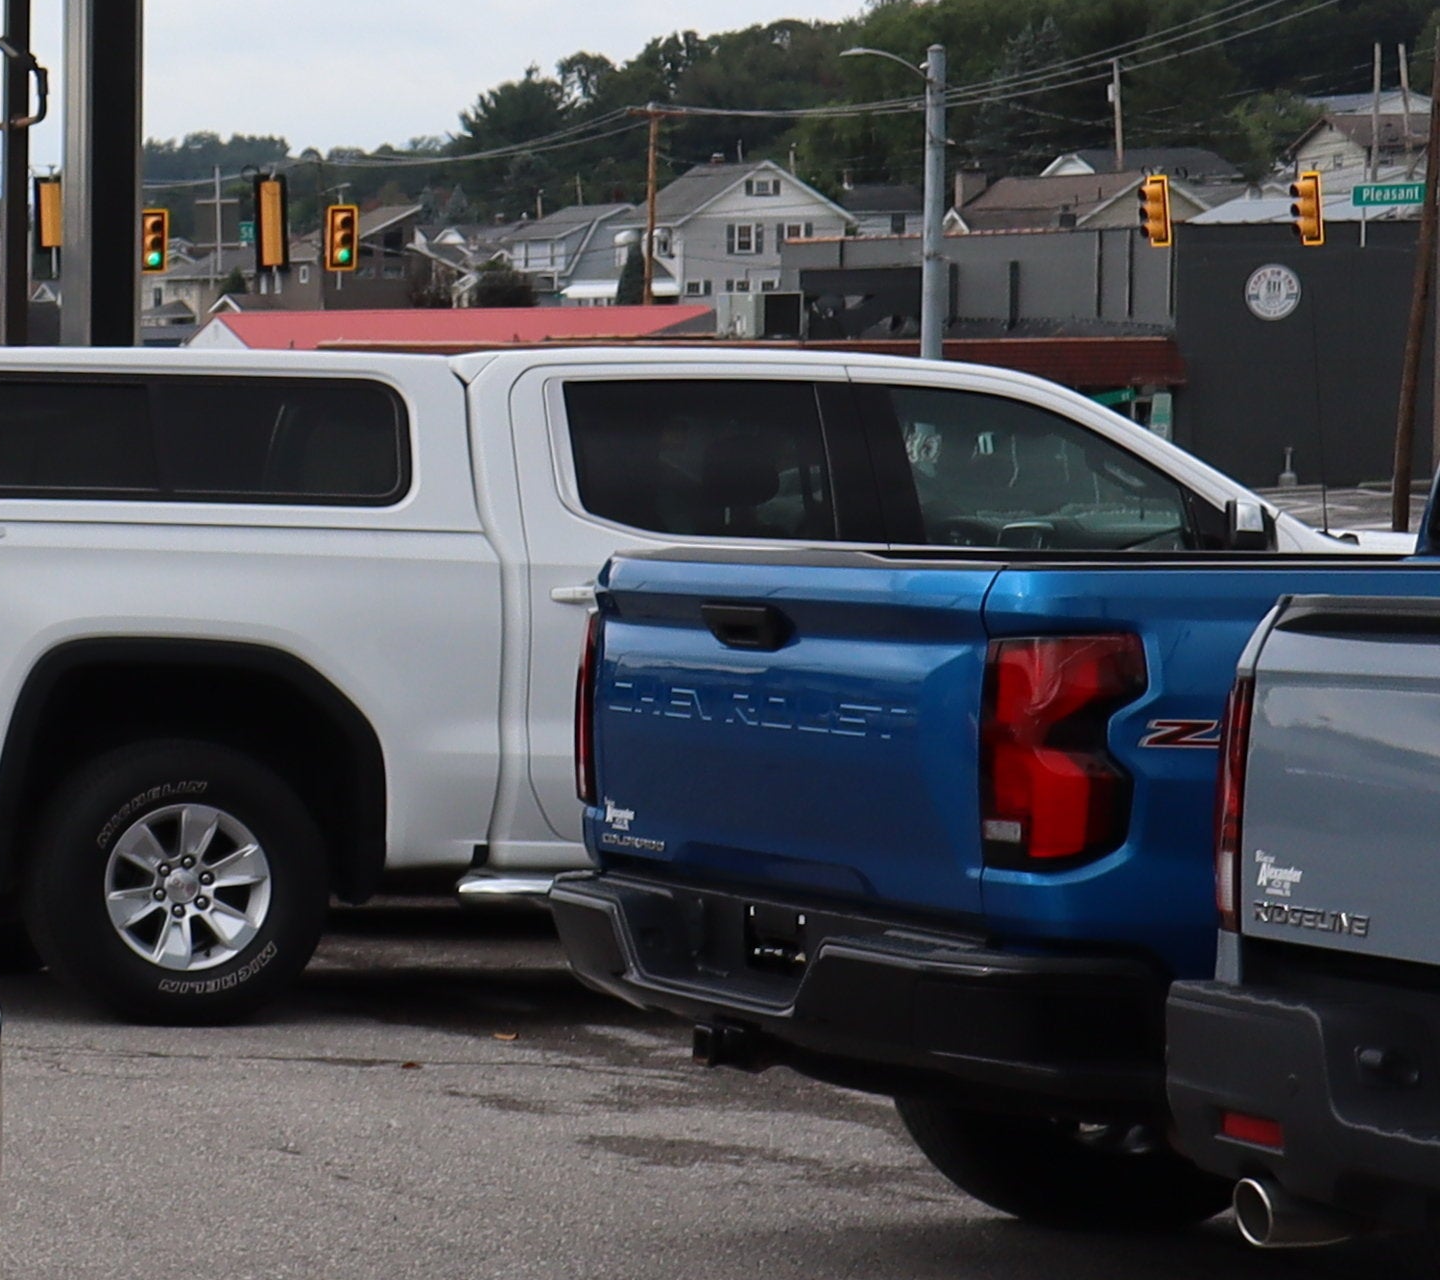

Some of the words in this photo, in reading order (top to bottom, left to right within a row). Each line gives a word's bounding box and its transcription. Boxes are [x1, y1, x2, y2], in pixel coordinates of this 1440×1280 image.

[1362, 187, 1420, 202] Pleasant
[609, 681, 909, 740] CHEVROLET
[96, 780, 208, 850] MICHELIN
[1254, 900, 1370, 937] RIDGELINE
[158, 940, 279, 994] MICHELIN
